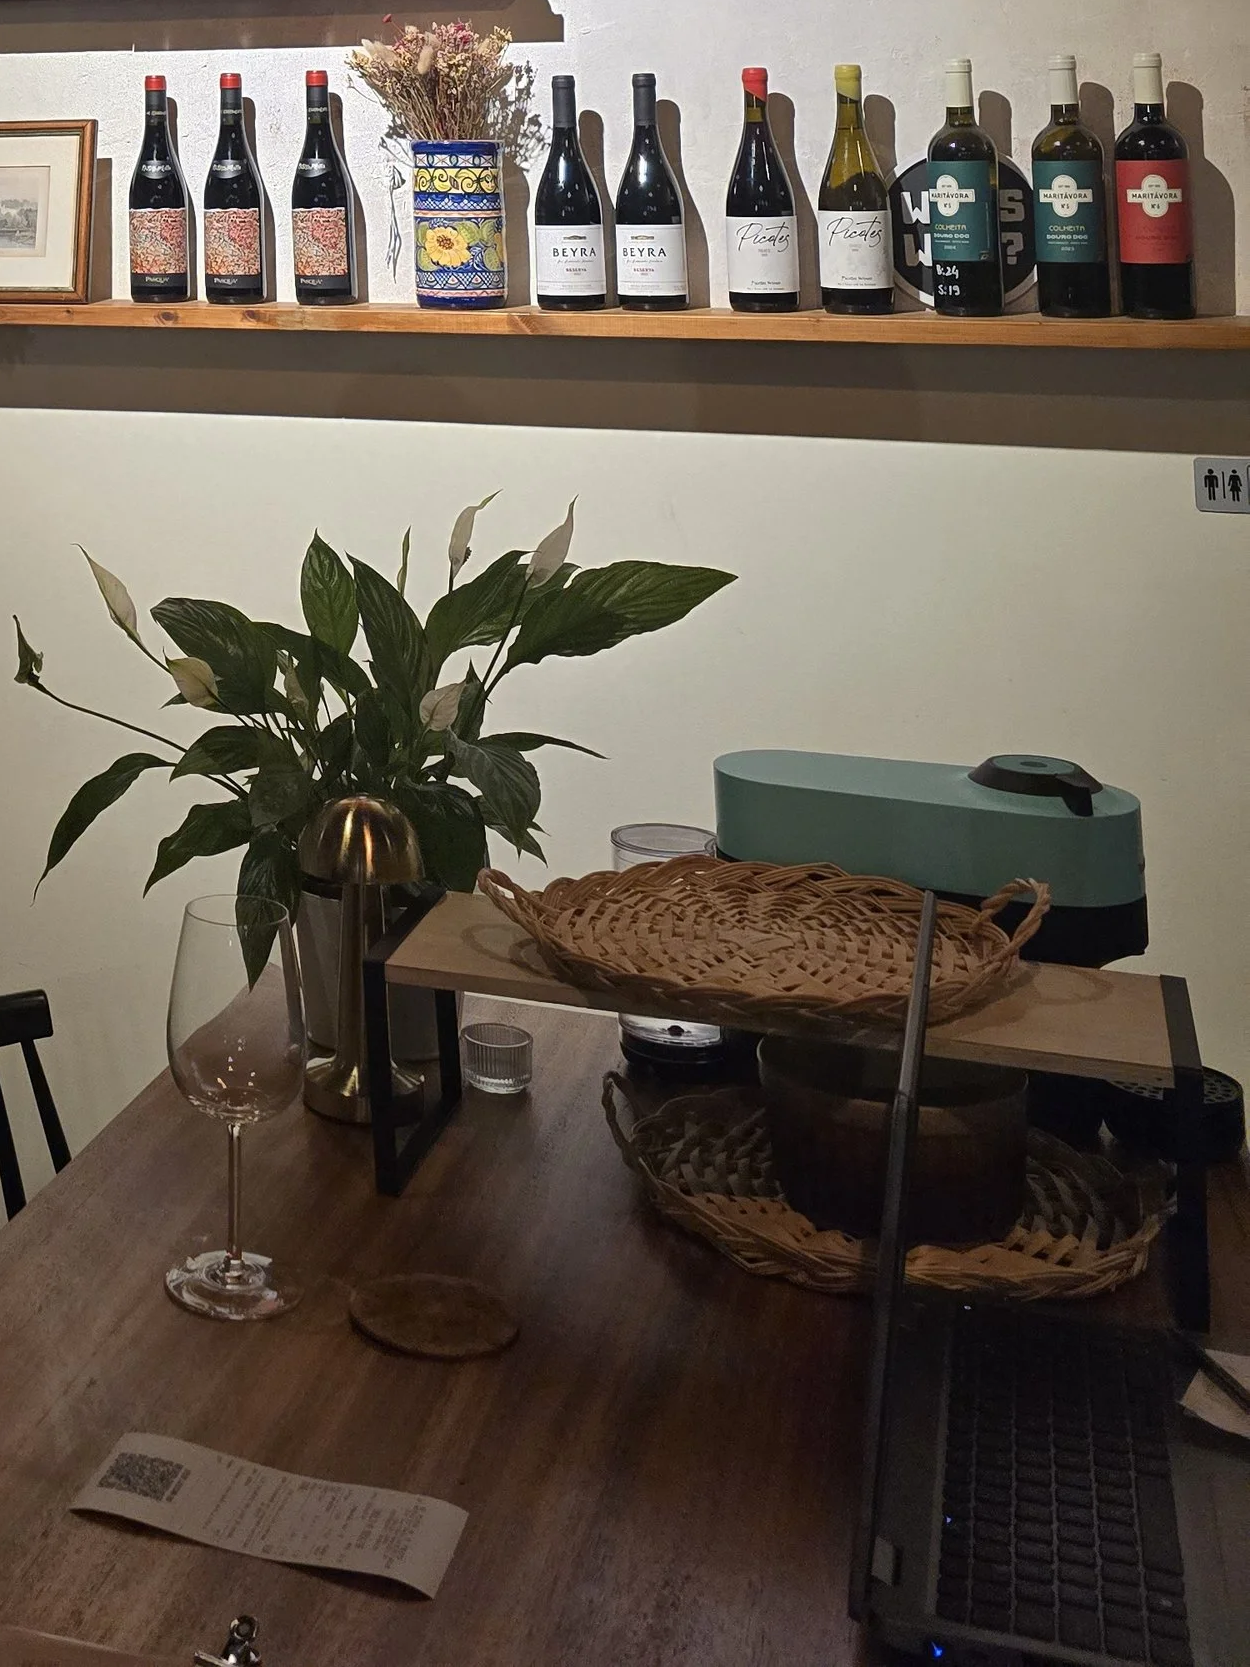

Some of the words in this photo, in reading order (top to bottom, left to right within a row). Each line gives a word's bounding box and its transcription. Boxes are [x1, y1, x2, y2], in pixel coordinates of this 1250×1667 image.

[1043, 191, 1088, 200] MARITÁVORA
[1131, 191, 1178, 200] MARITÁVORA
[552, 247, 597, 257] BEYRA
[623, 247, 667, 257] BEYRA
